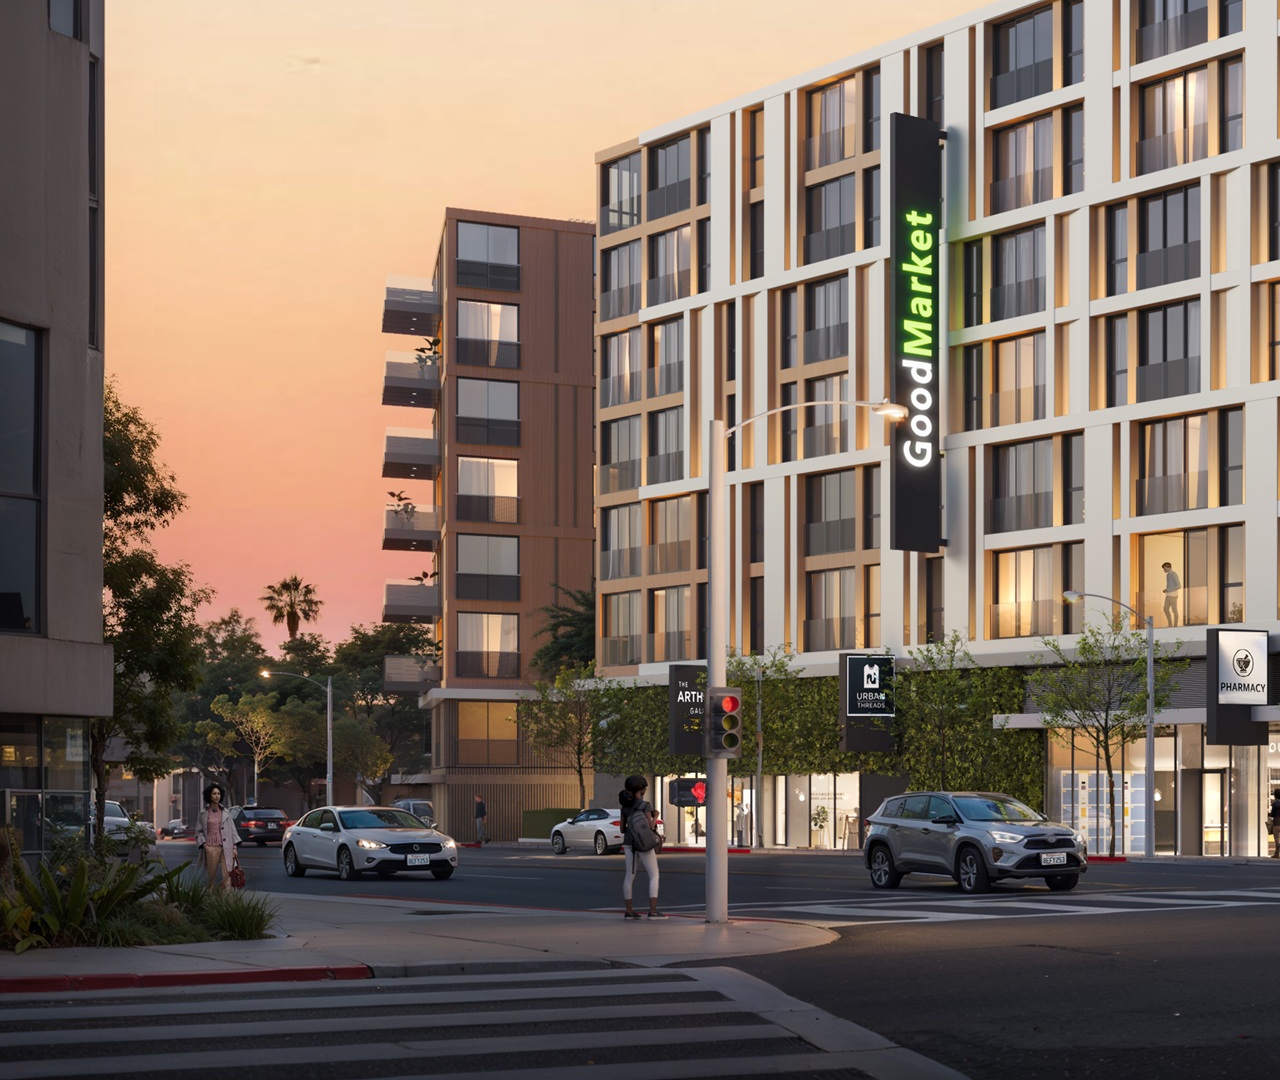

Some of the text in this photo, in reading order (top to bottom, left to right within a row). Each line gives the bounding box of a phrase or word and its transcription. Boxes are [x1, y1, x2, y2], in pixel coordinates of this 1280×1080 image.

[902, 210, 933, 468] GoodMarket
[1220, 682, 1266, 693] PHARMACY
[856, 692, 886, 700] URBAN
